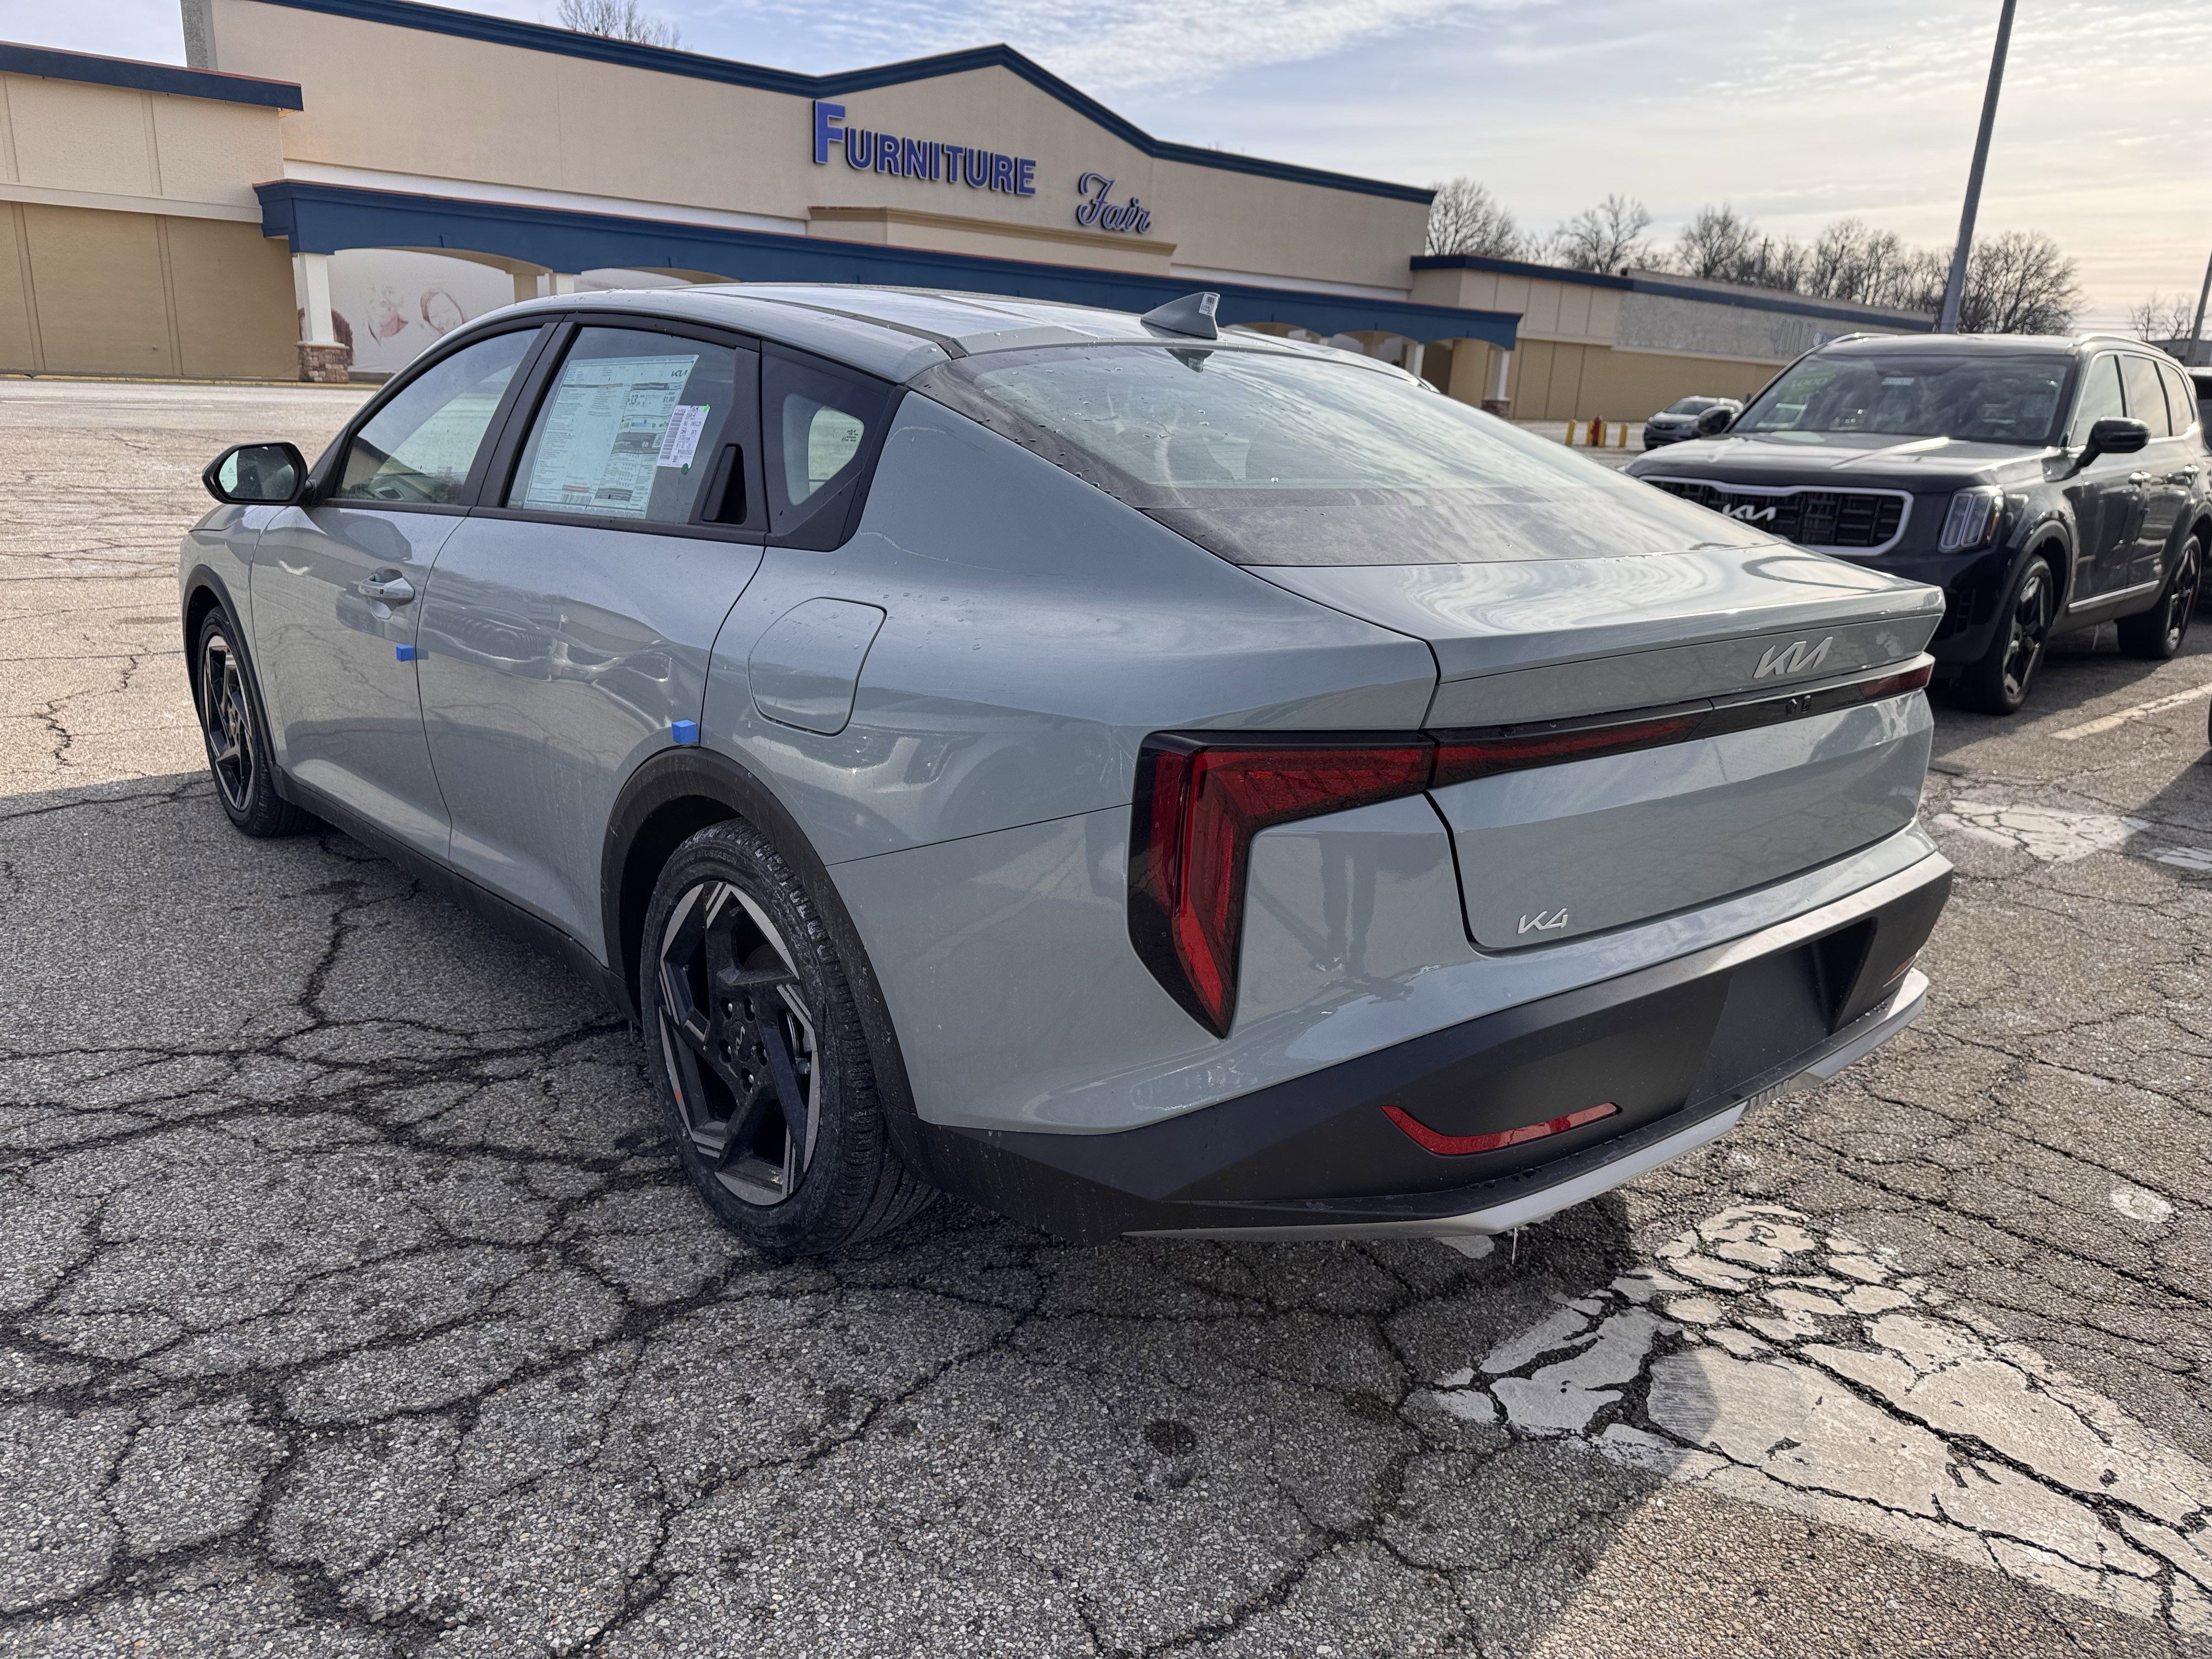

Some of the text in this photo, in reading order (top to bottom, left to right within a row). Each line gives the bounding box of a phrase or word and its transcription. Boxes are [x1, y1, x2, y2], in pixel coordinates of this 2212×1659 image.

[812, 99, 1037, 196] FURNITURE
[1076, 171, 1152, 234] Fair
[1722, 503, 1777, 521] KIA
[1753, 636, 1833, 679] KIA
[1517, 908, 1568, 934] K4
